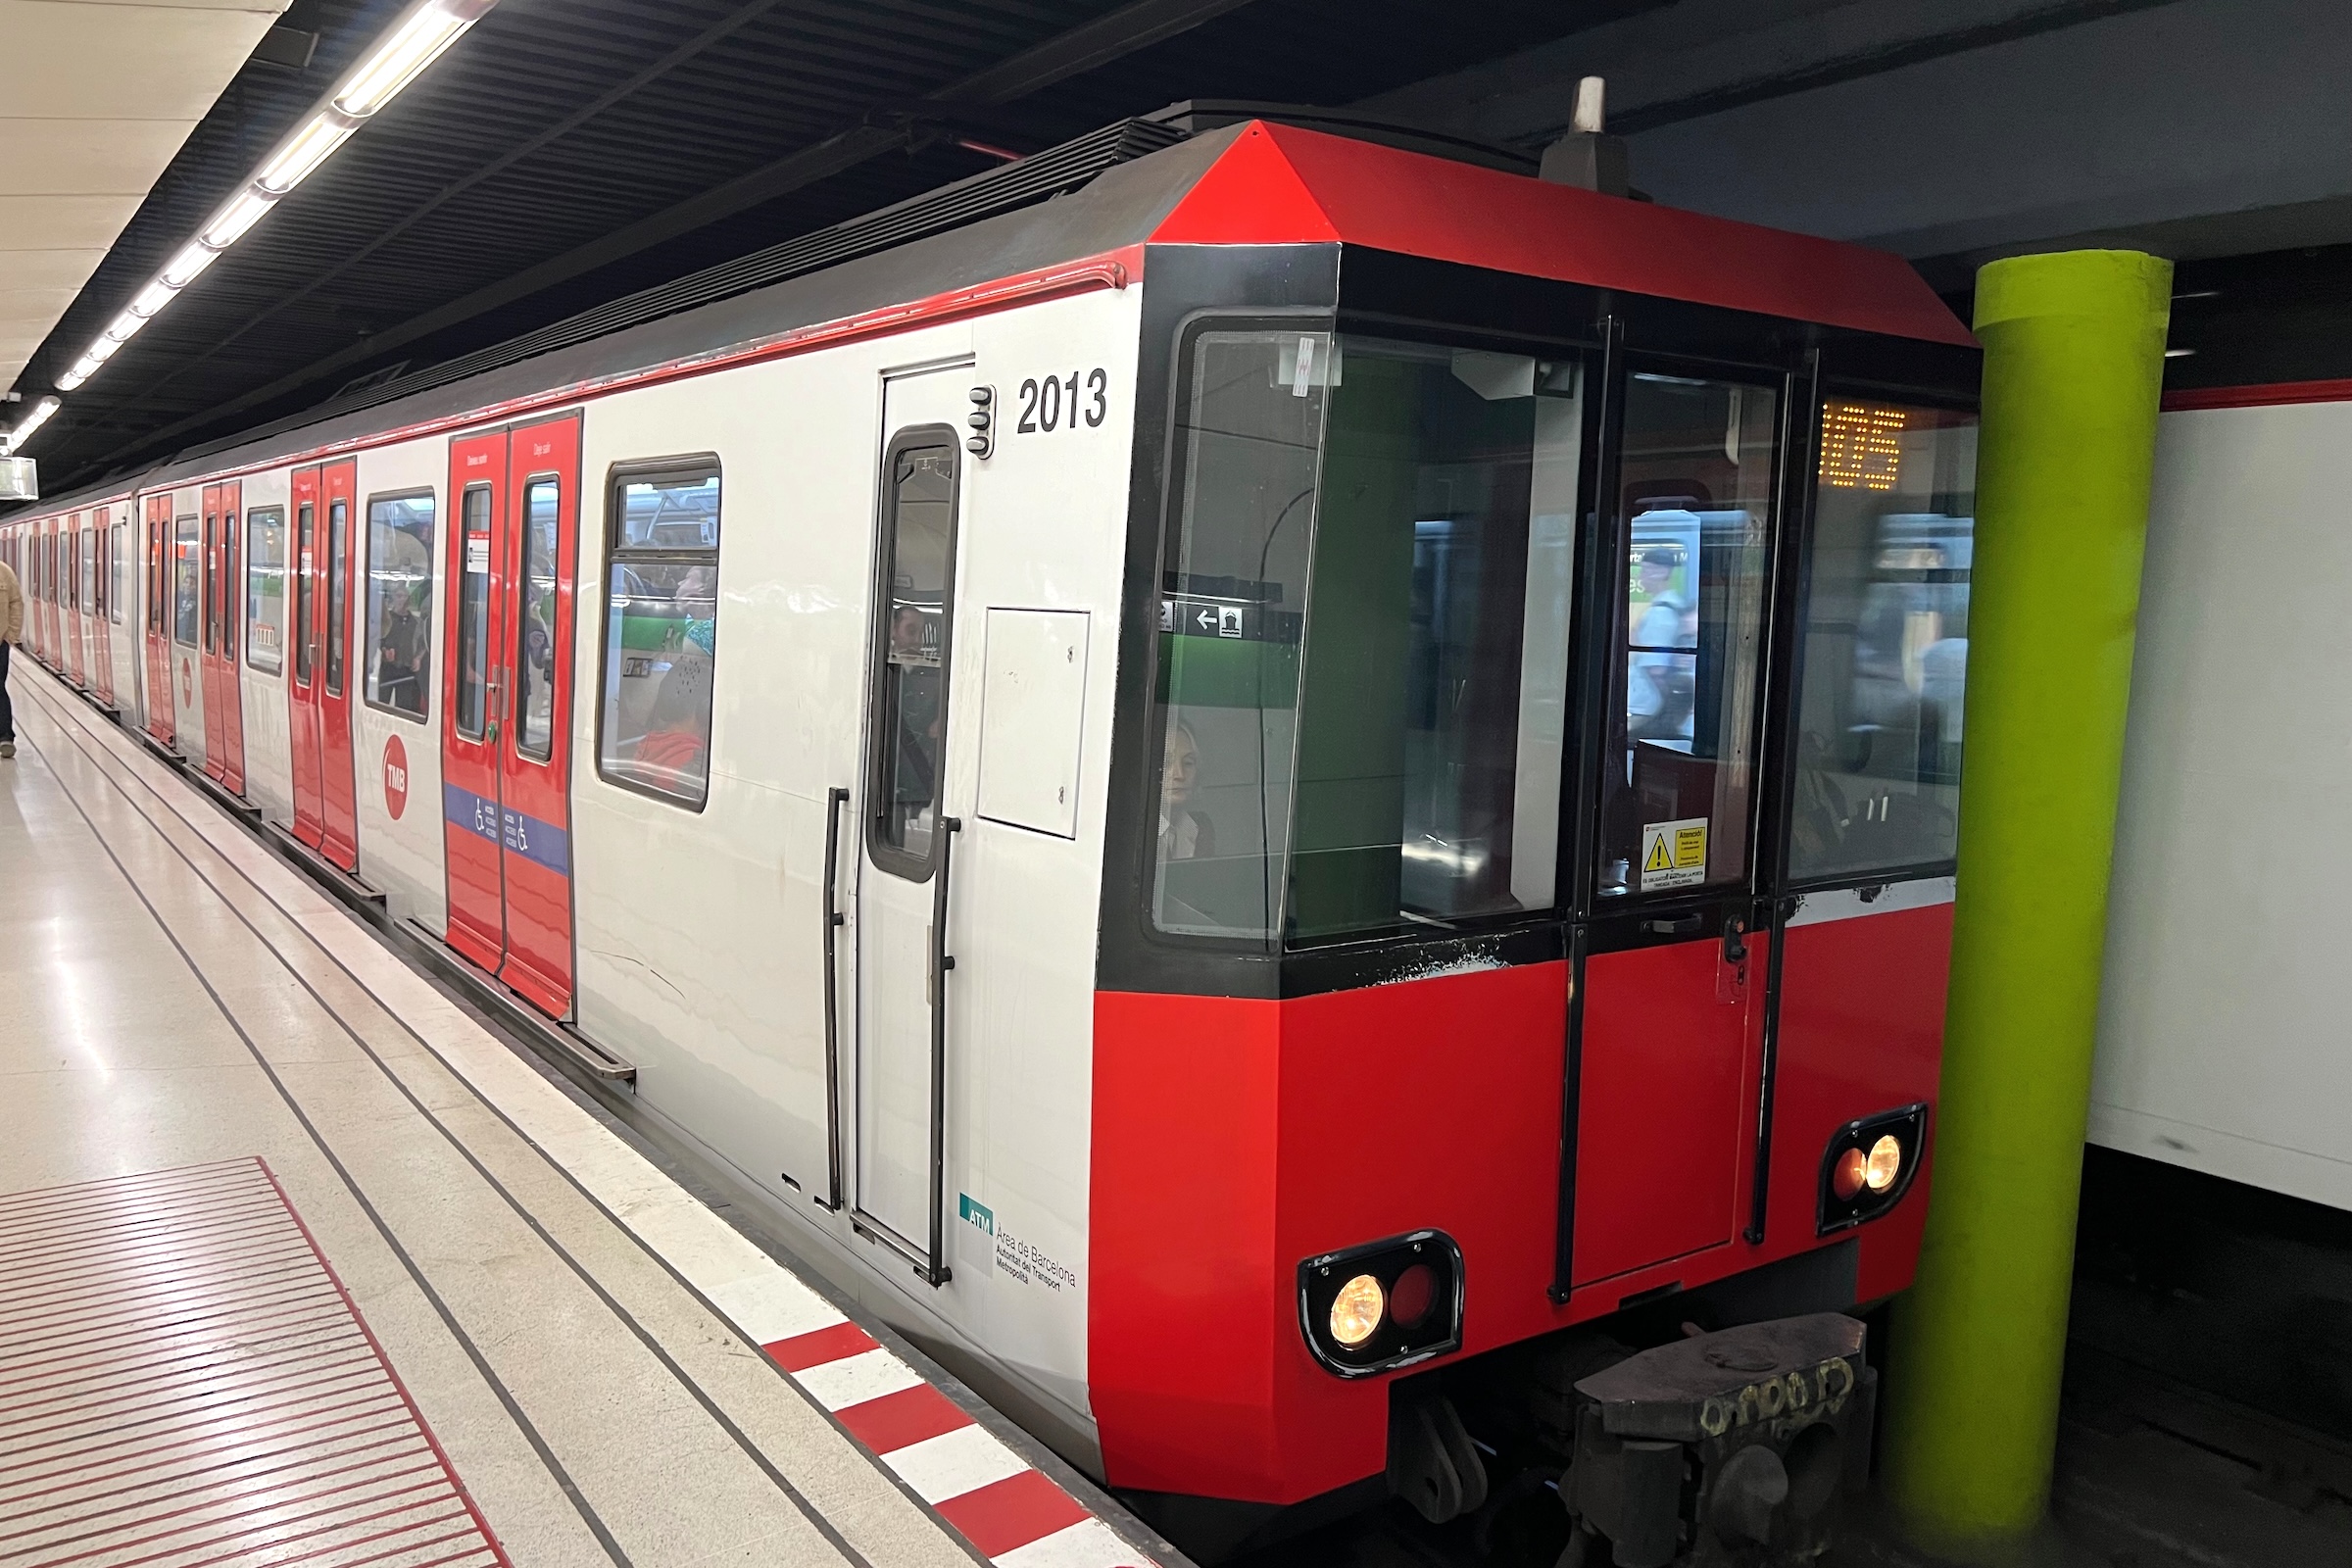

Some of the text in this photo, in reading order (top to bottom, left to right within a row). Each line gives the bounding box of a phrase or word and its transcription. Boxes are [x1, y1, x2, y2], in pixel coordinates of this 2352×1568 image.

[1017, 368, 1106, 434] 2013
[387, 763, 406, 793] TMB
[968, 1209, 990, 1233] ATM
[997, 1222, 1076, 1288] Àrea de Barcelona
[997, 1245, 1060, 1292] Autoritat del Transport
[997, 1256, 1029, 1285] Metropolità
